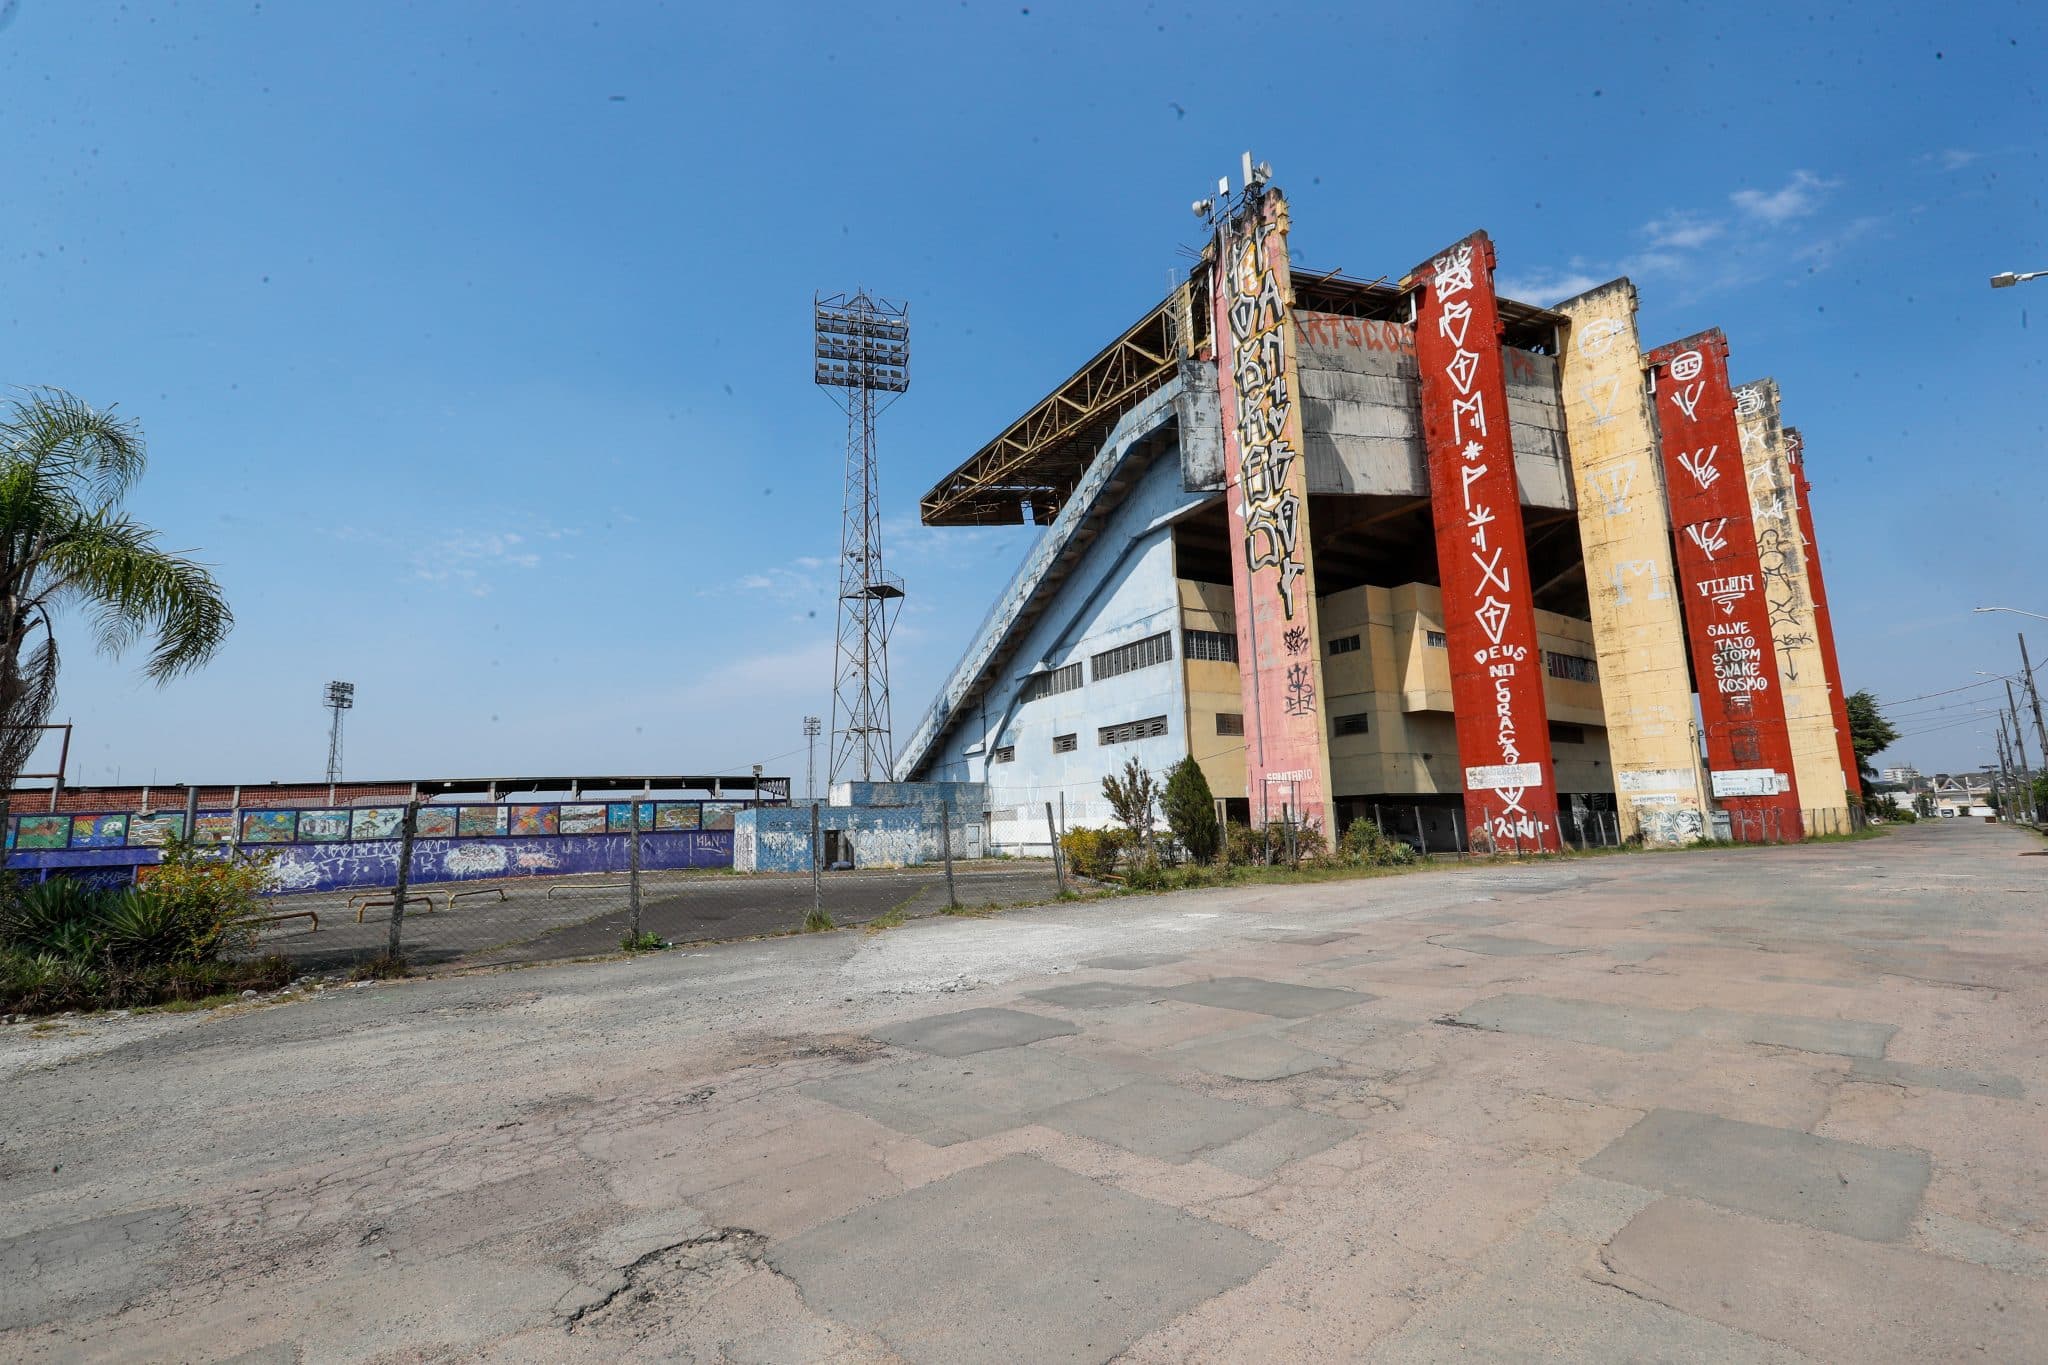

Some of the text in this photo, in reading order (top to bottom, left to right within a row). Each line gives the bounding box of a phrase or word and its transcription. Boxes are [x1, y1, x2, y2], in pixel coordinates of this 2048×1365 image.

[1707, 622, 1751, 636] SALVE
[1714, 636, 1755, 651] TAJO
[1474, 644, 1527, 665] DEUS
[1489, 663, 1515, 678] NO
[1714, 662, 1760, 679] SNAKE
[1718, 677, 1768, 693] KOSMO
[1495, 679, 1520, 765] CORAÇÃO
